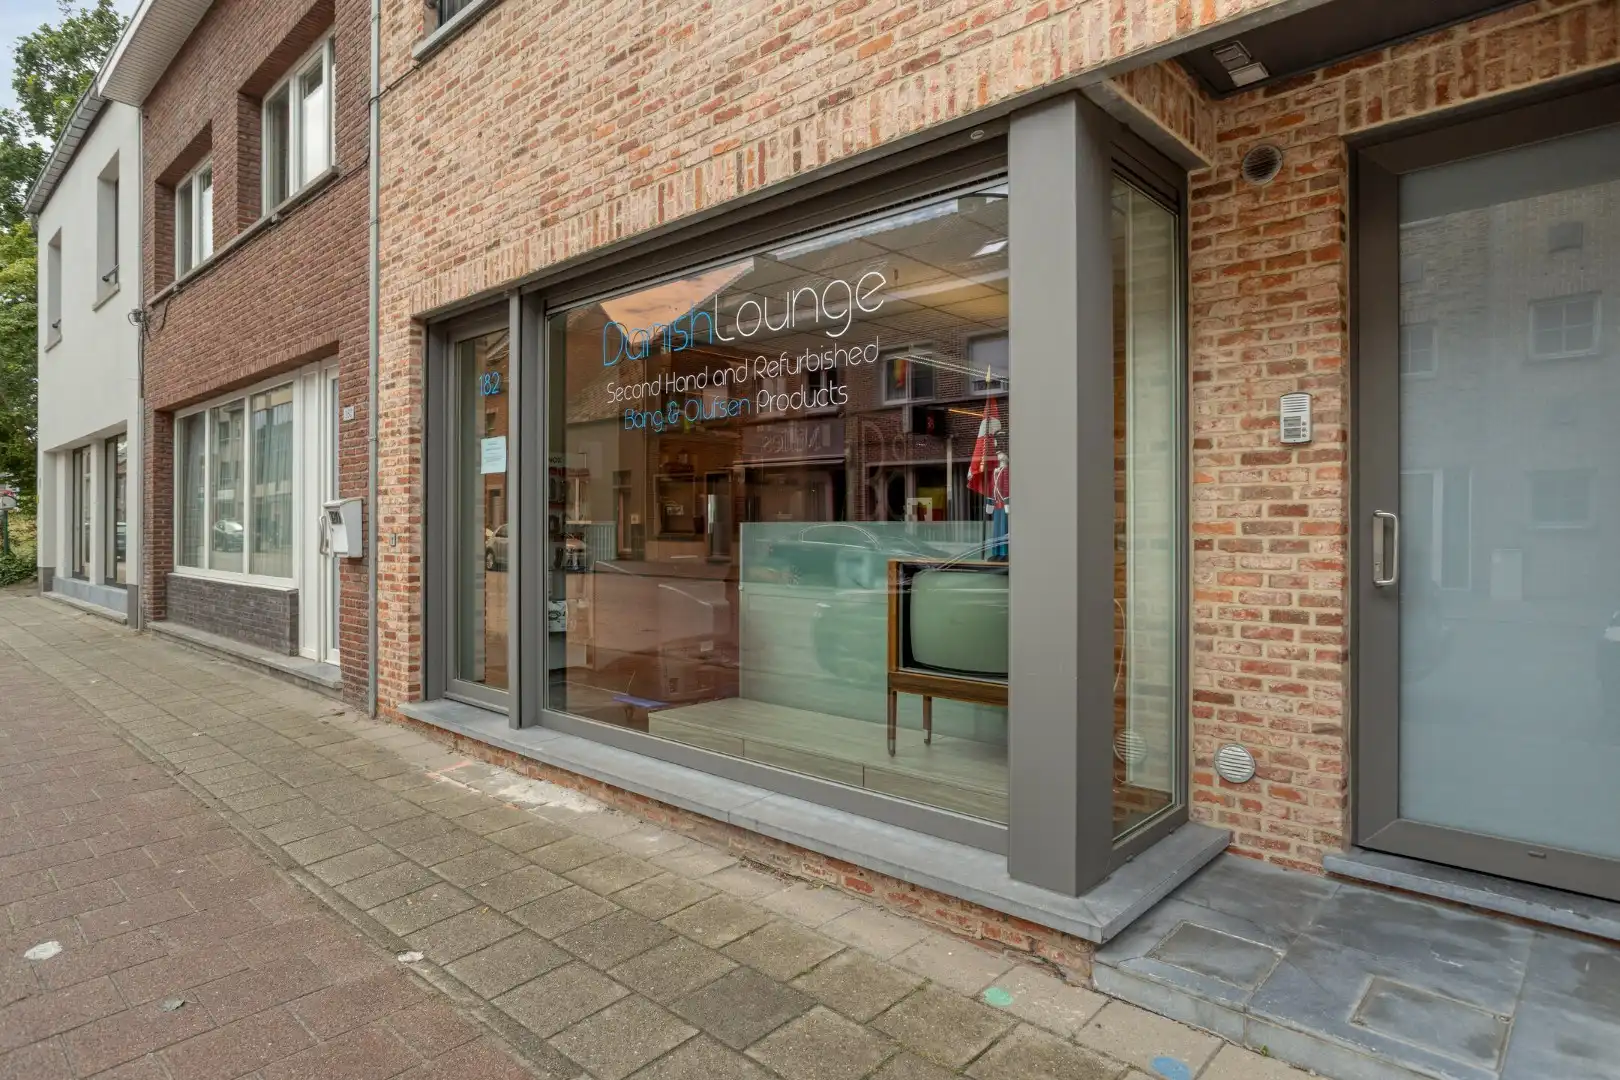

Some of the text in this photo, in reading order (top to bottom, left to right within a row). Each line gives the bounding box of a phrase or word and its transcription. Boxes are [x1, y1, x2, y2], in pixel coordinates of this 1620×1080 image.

[479, 371, 500, 396] 182
[607, 335, 879, 404] Second Hand and Refurbished
[624, 380, 848, 432] Bang & Olufsen Products
